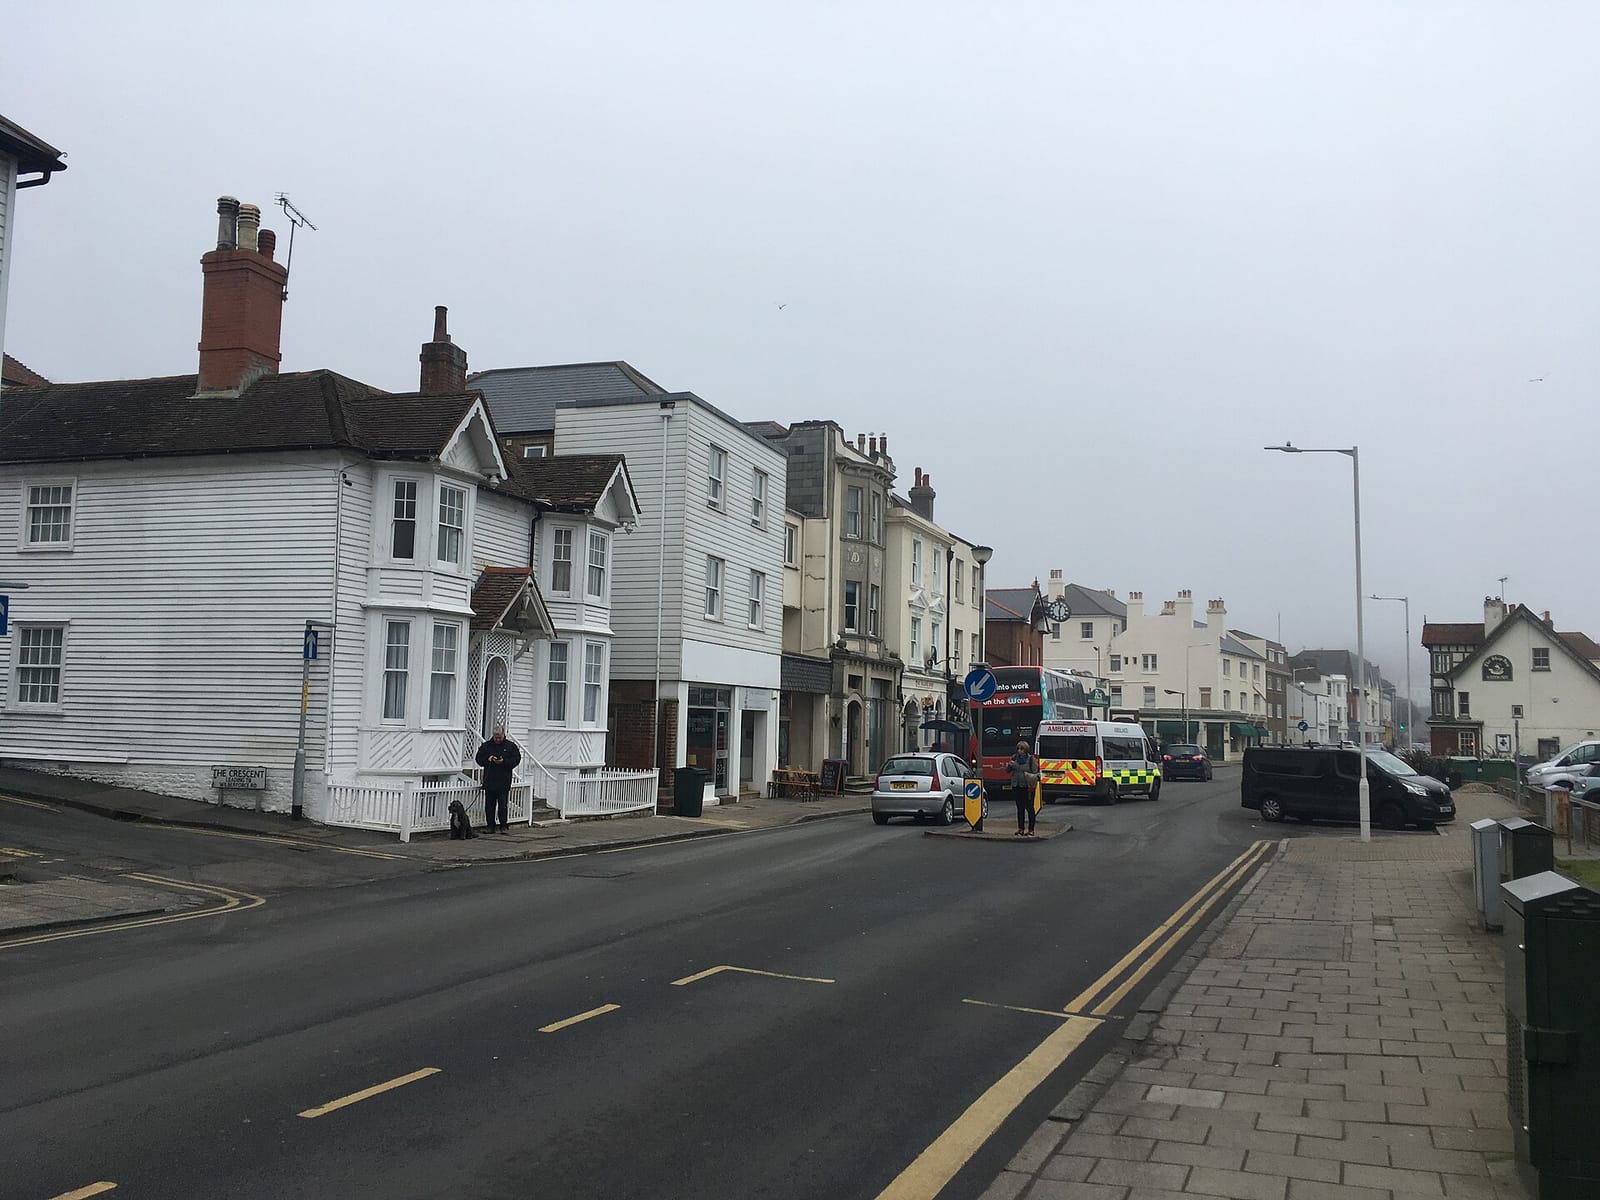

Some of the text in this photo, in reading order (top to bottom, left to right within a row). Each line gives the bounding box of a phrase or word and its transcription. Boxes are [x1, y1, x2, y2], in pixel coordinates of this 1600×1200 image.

[1011, 682, 1029, 690] work
[213, 769, 264, 778] THE CRESCENT
